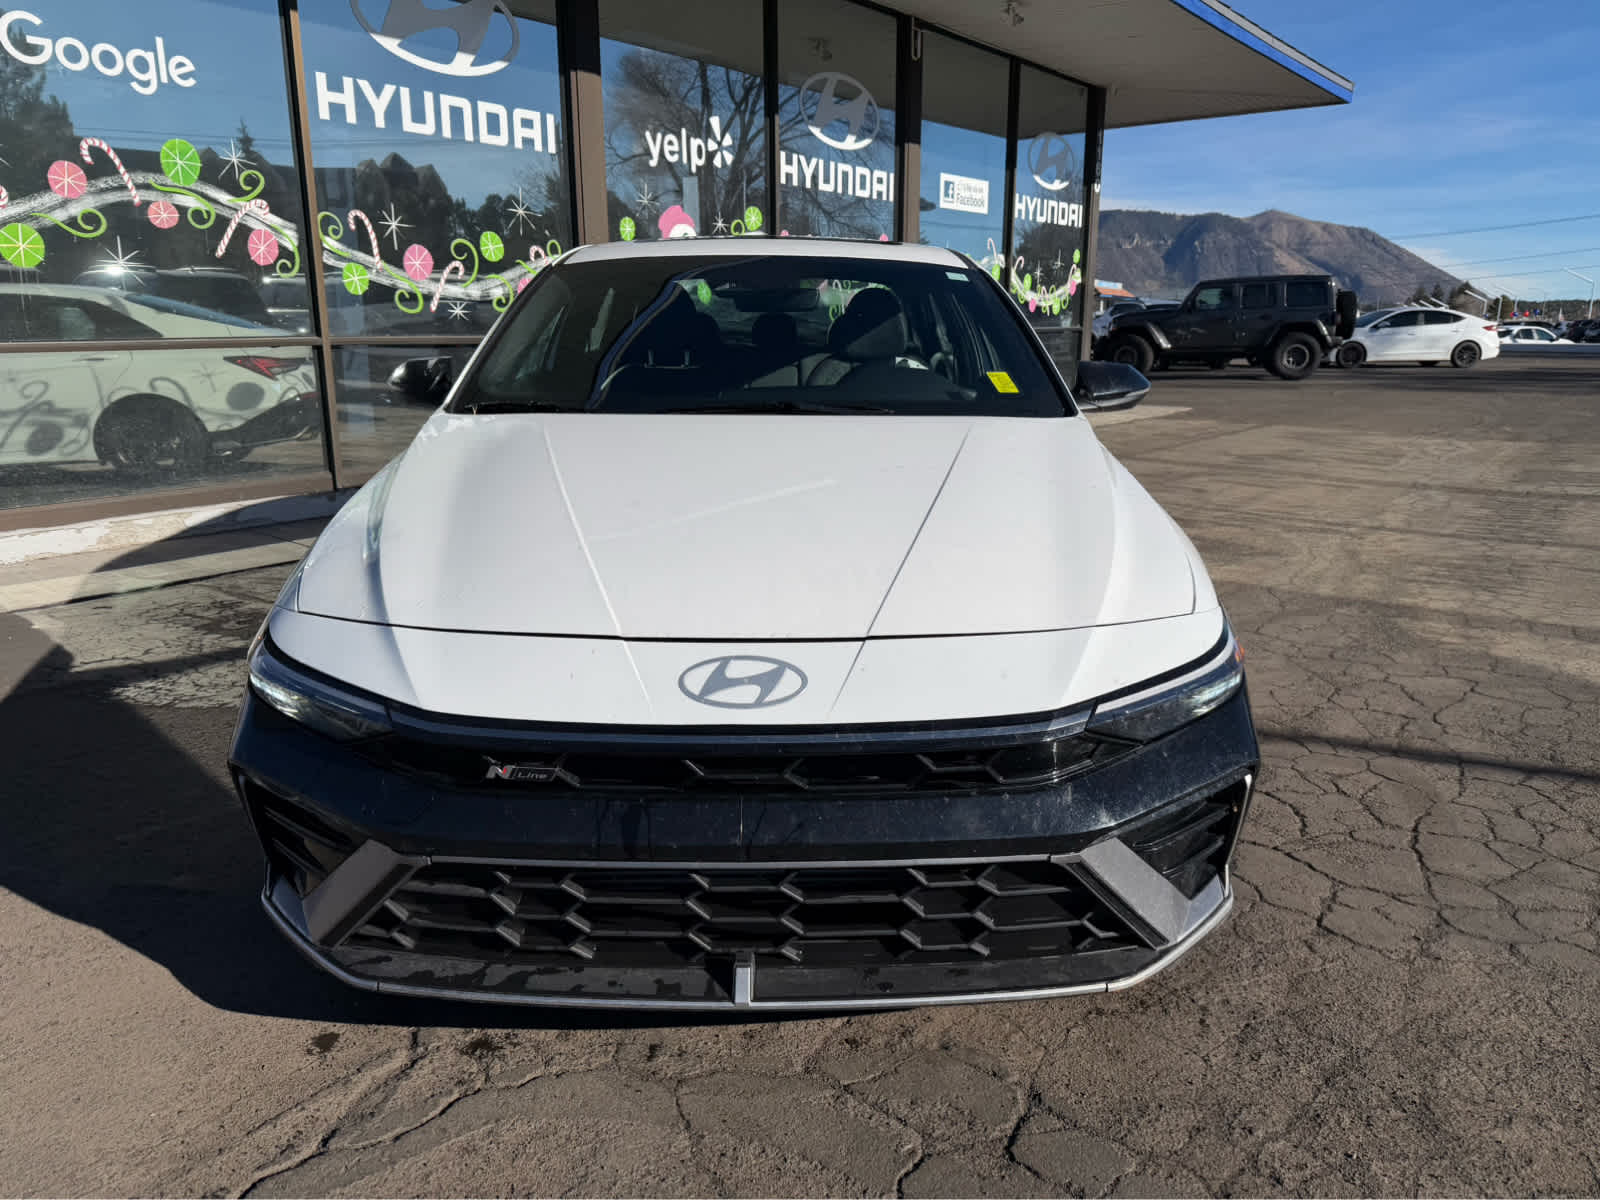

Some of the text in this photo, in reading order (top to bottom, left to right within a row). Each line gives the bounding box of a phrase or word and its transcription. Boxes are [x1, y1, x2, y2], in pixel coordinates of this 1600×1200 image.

[0, 10, 197, 95] Google
[315, 71, 557, 154] HYUNDAI
[645, 128, 706, 173] yelp
[780, 150, 895, 202] HYUNDAI
[1014, 193, 1083, 228] HYUNDAI
